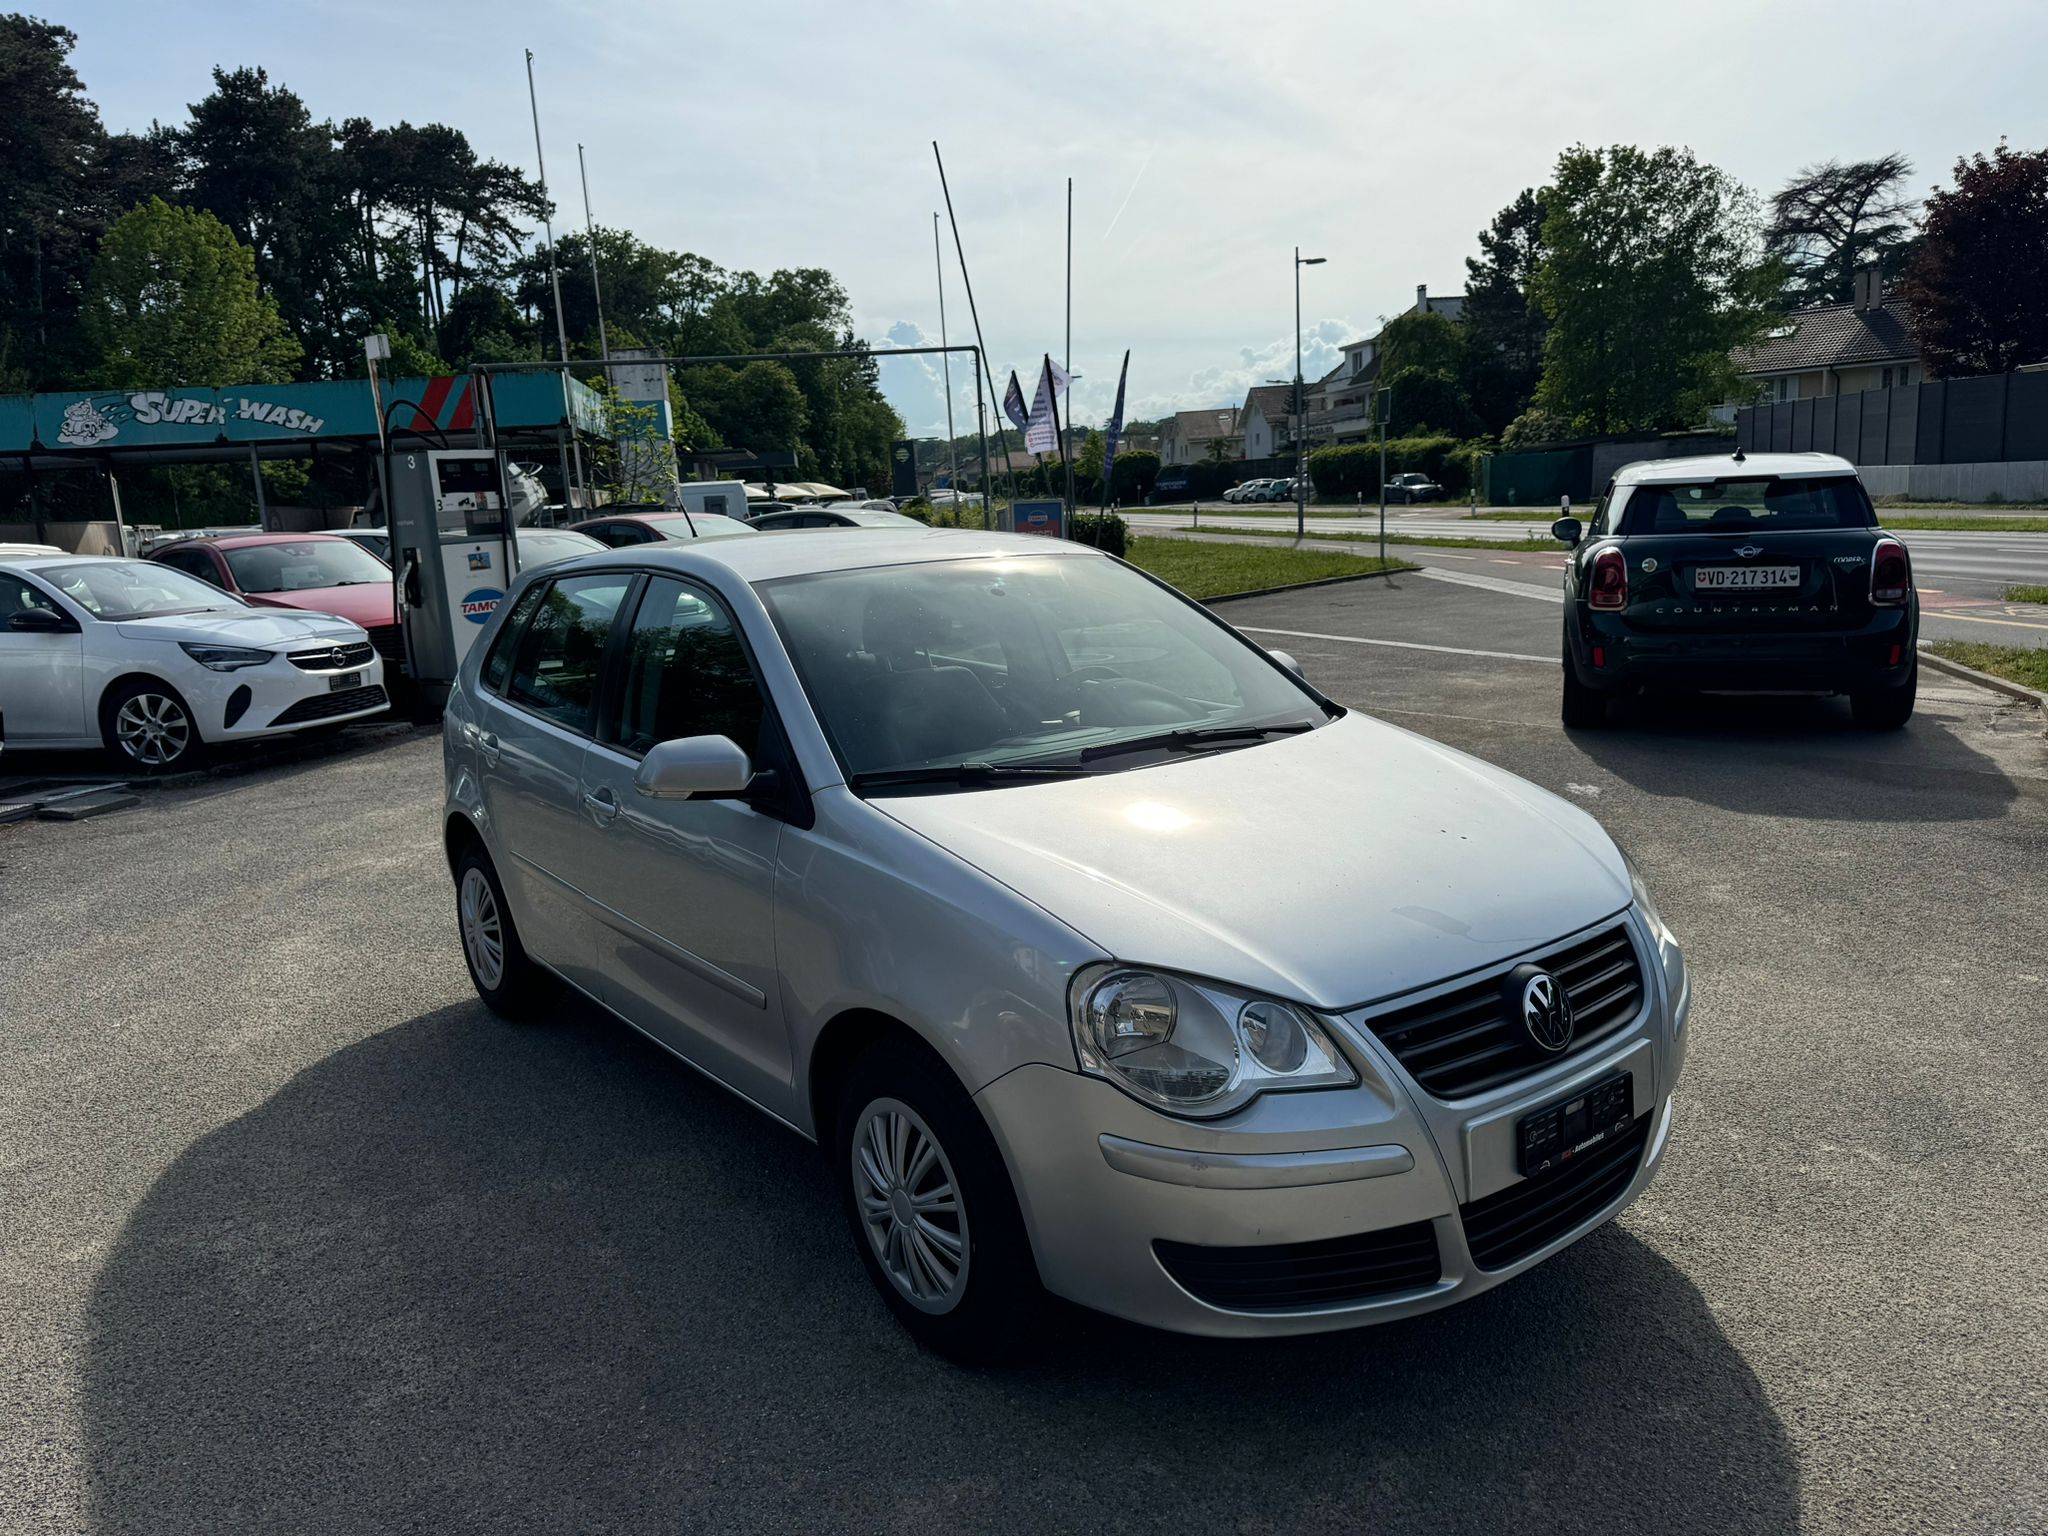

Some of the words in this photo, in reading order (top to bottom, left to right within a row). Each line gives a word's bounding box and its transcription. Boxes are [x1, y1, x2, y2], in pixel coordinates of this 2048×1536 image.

[130, 391, 226, 425] SUPER
[239, 398, 325, 434] WASH
[407, 455, 416, 469] 3
[436, 499, 443, 511] 3
[1655, 604, 1839, 614] COUNTRYMAN
